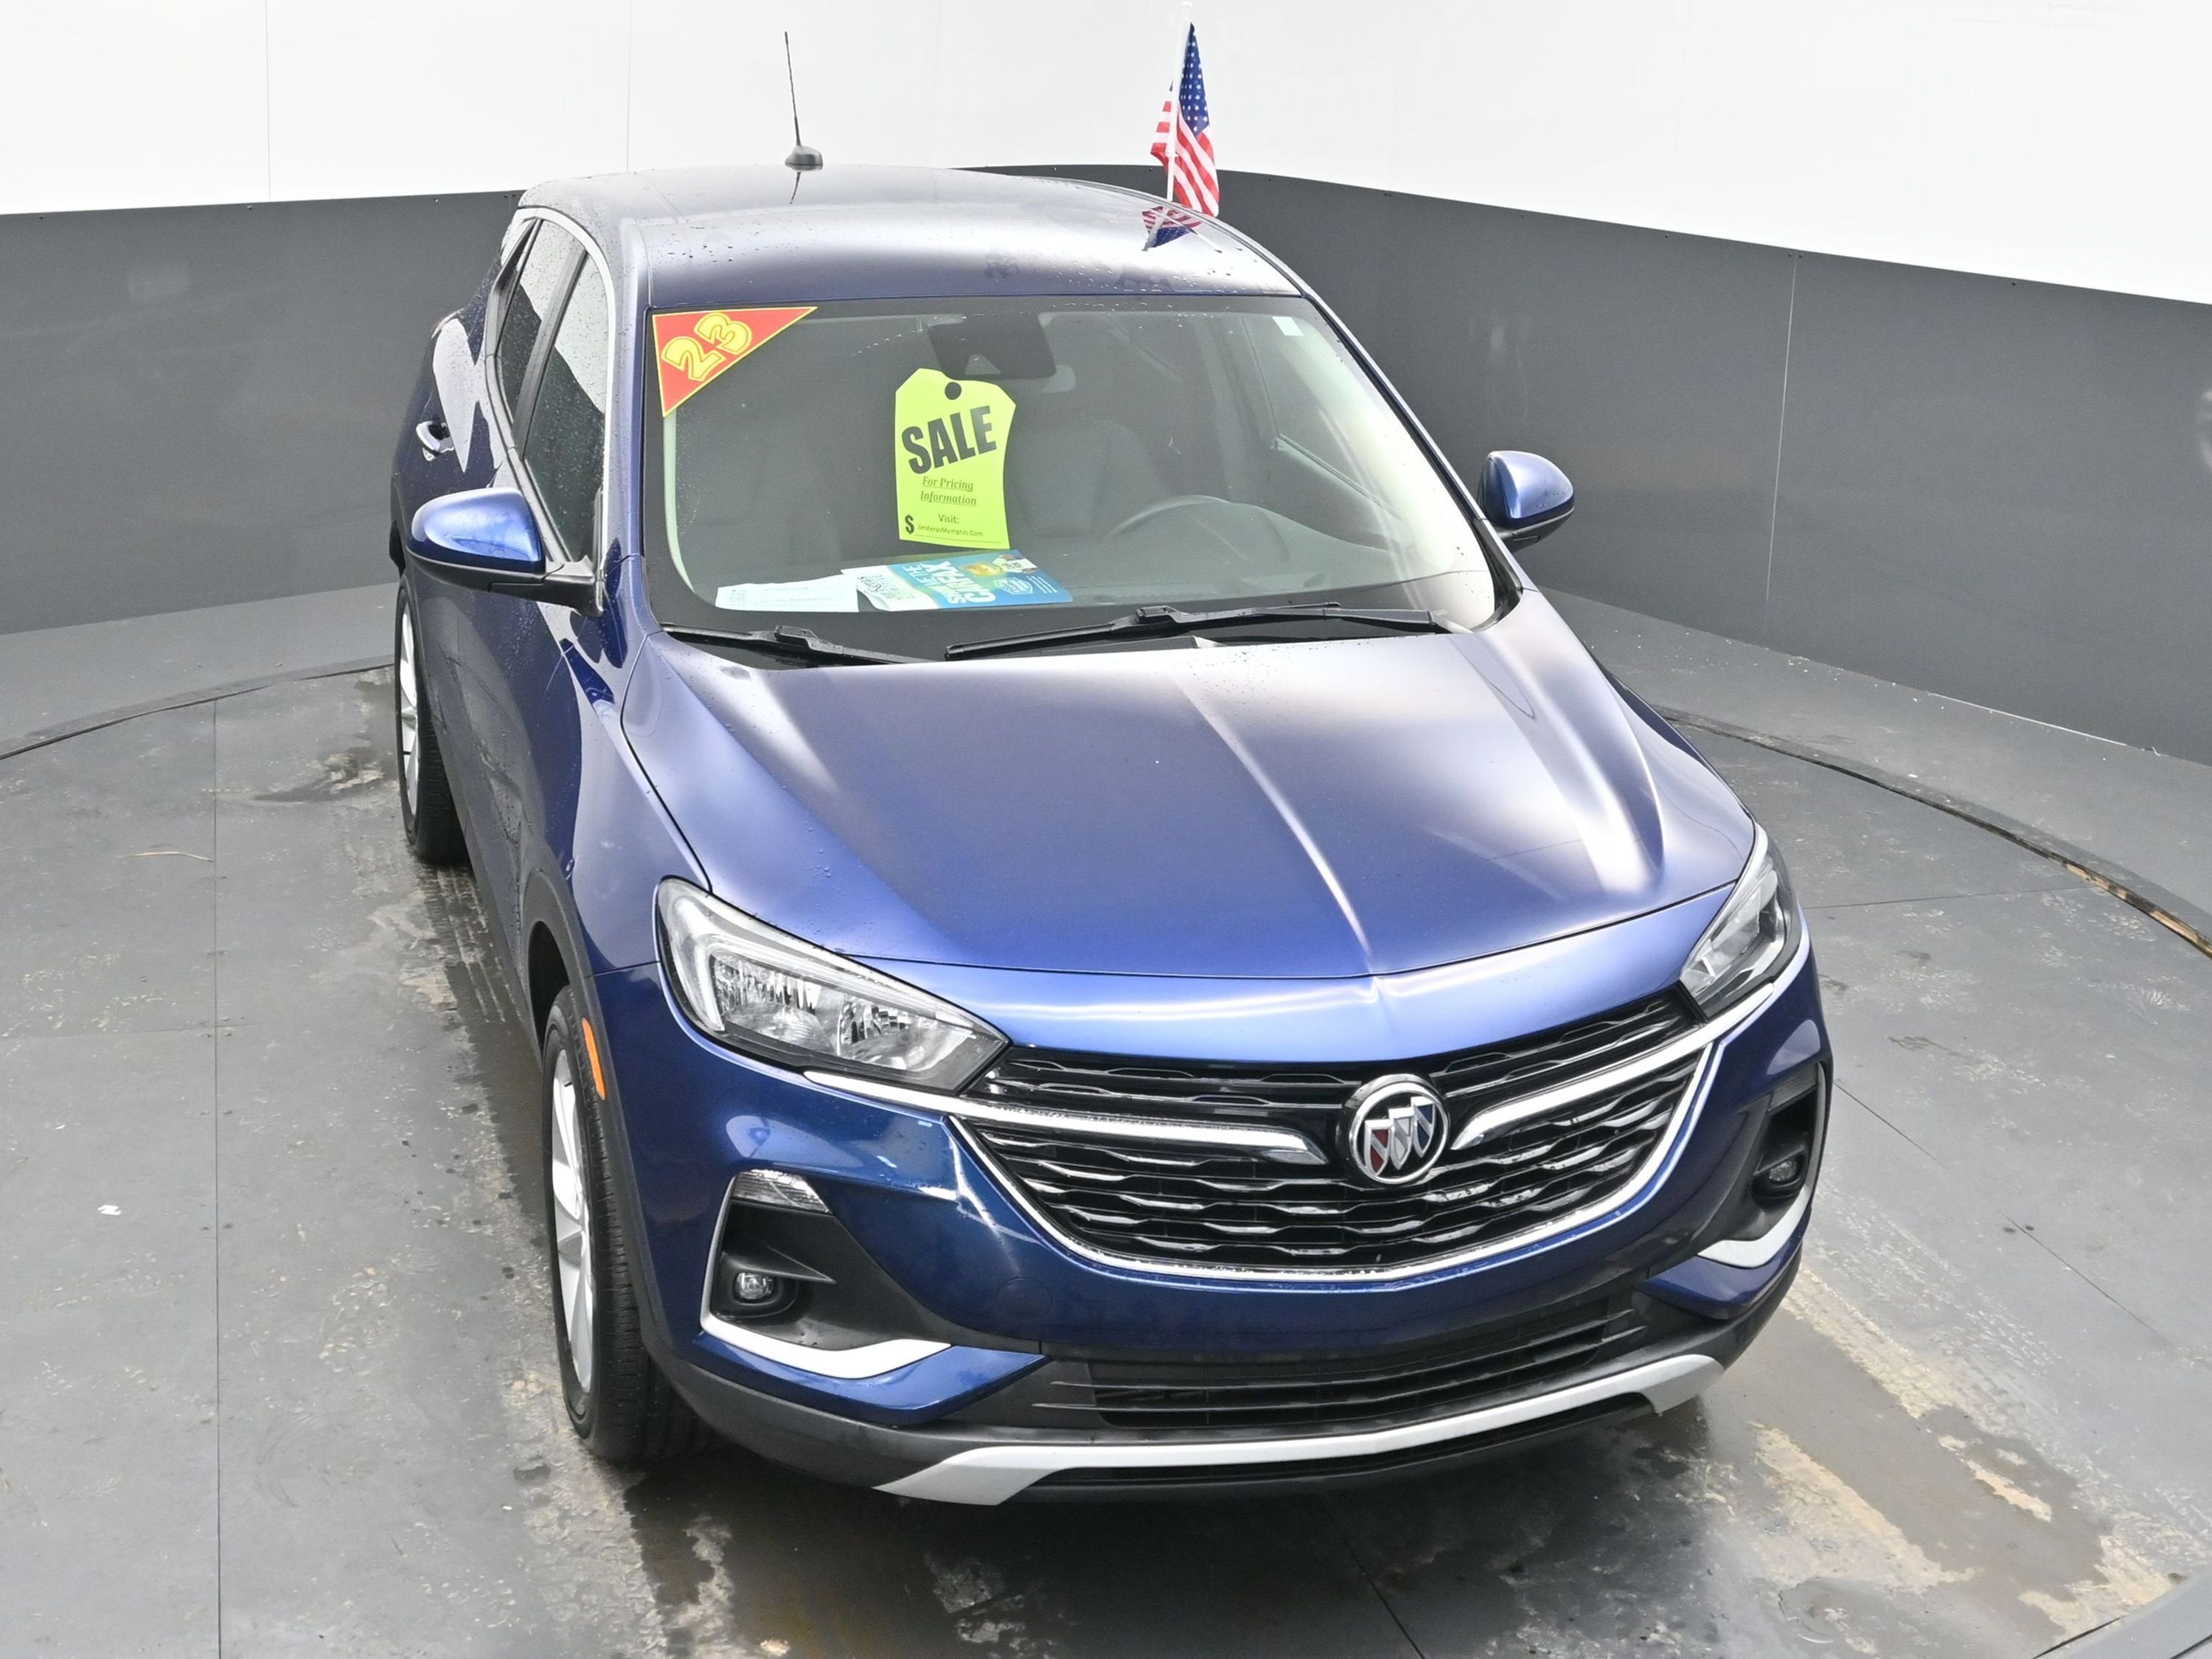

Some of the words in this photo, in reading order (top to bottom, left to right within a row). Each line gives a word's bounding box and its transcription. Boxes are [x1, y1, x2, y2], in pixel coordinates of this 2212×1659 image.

[661, 312, 752, 382] 23
[901, 406, 997, 474] SALE
[922, 476, 938, 487] For
[939, 478, 974, 493] Pricing
[920, 490, 978, 506] Information
[905, 514, 914, 535] $
[938, 513, 960, 524] Visit:
[920, 560, 997, 603] CARFAX
